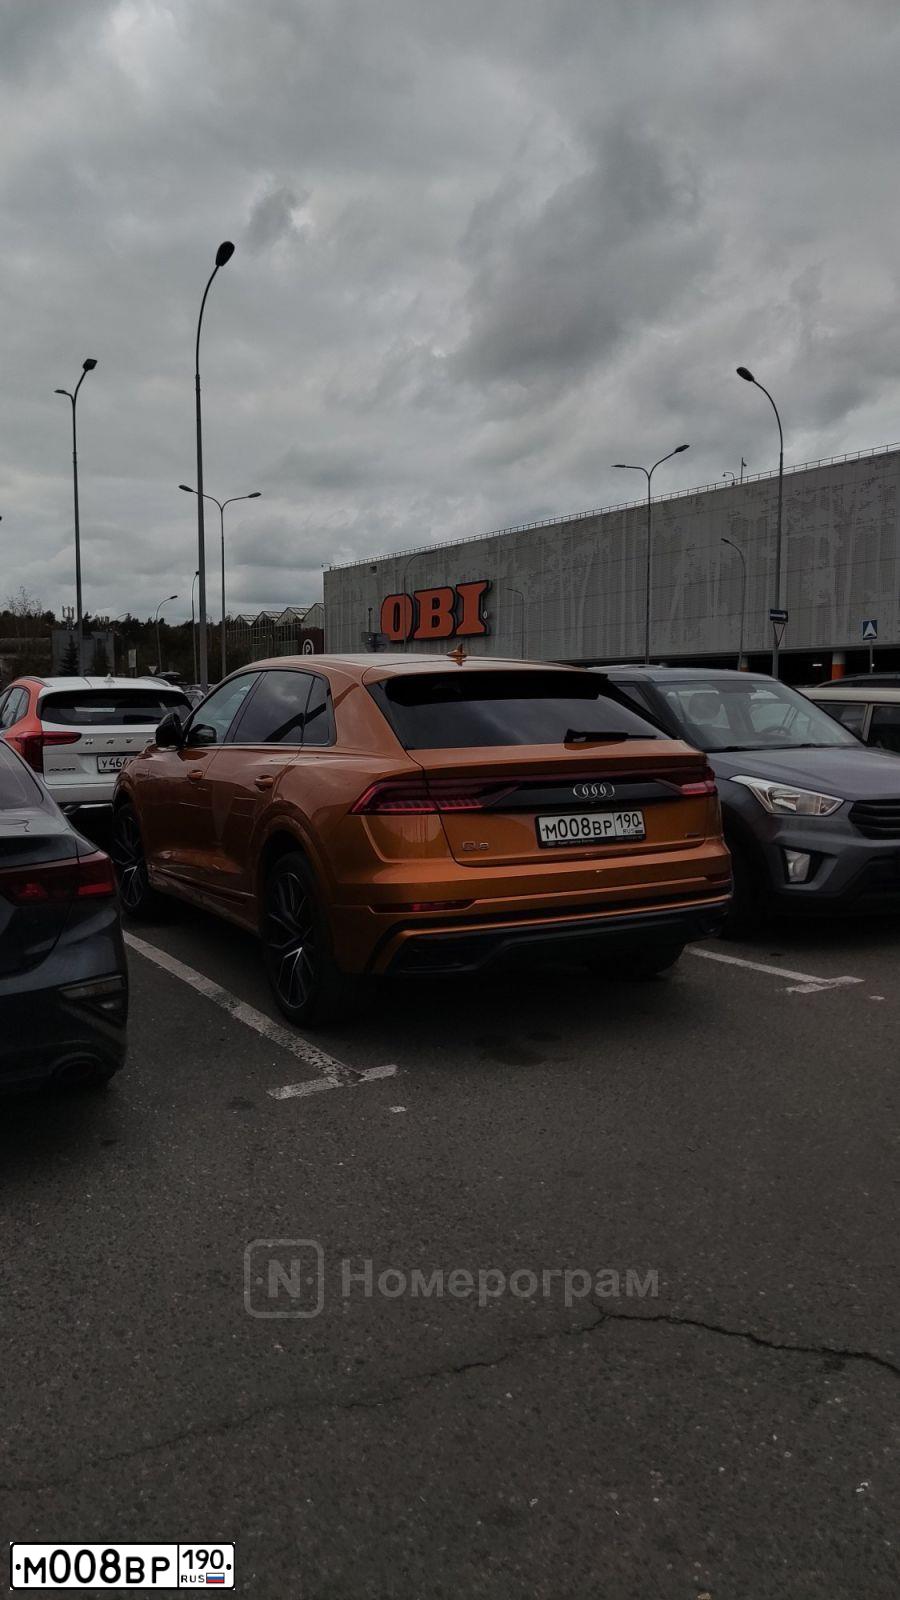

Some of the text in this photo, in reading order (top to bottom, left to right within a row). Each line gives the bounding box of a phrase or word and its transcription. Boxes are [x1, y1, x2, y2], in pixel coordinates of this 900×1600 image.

[380, 580, 490, 643] OBI
[544, 813, 641, 839] М008ВР 190
